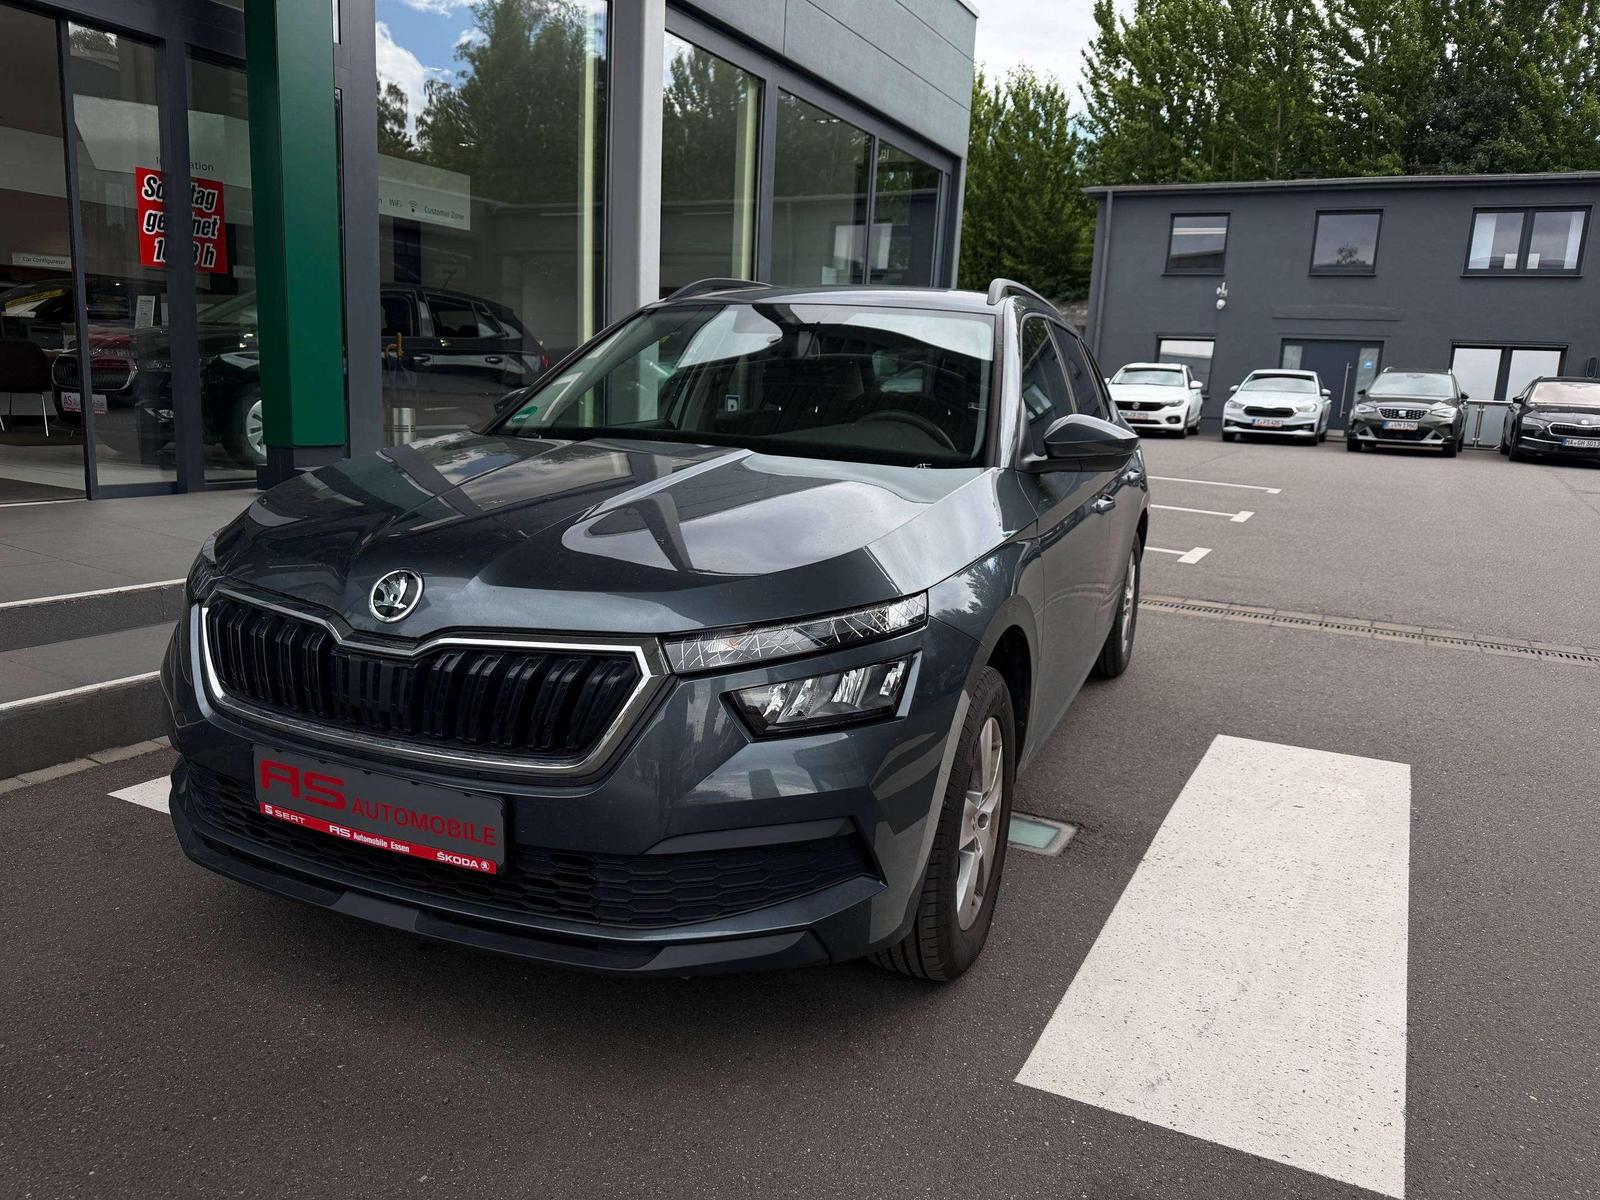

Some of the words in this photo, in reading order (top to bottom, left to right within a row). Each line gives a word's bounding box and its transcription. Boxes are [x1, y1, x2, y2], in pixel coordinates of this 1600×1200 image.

[201, 243, 217, 268] h
[259, 759, 346, 810] AS
[351, 797, 497, 847] AUTOMOBILE
[274, 809, 306, 824] SEAT
[329, 825, 351, 838] AS
[353, 831, 388, 848] Automobile
[390, 841, 410, 854] Essen
[436, 851, 479, 869] ŠKODA
